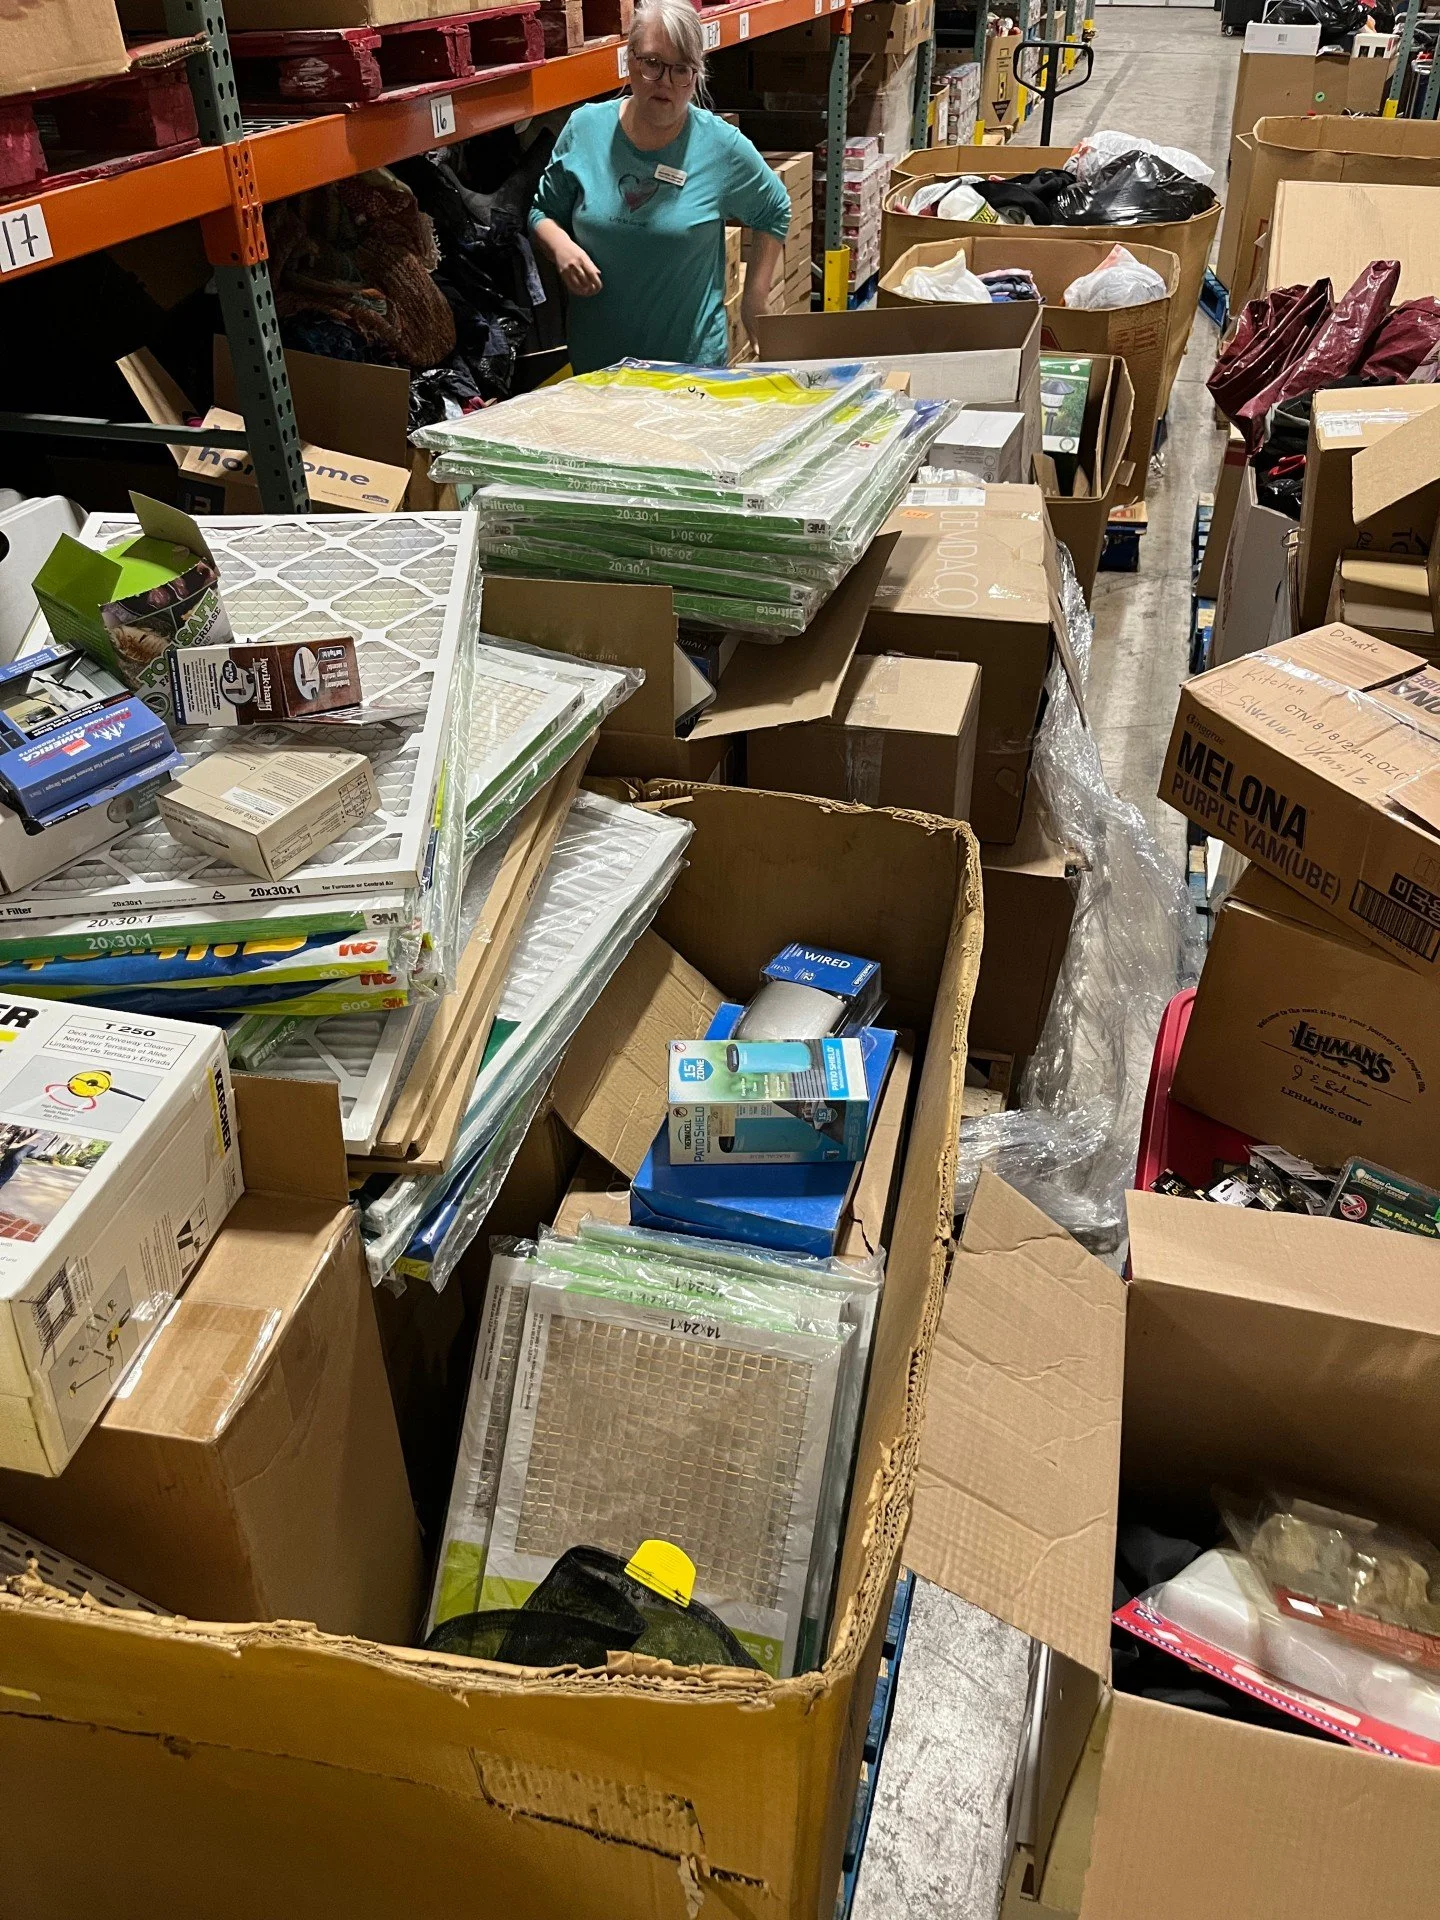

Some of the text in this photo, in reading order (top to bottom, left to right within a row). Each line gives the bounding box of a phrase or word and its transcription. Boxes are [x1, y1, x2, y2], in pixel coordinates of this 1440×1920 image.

[435, 104, 449, 132] 16
[2, 212, 39, 266] 17
[616, 509, 660, 522] 20x30x1
[671, 529, 714, 544] 20x30x1
[807, 522, 826, 534] 3M
[609, 561, 651, 577] 20x30x1
[933, 510, 979, 610] DEMDACO
[177, 588, 219, 648] SAFE
[194, 606, 222, 646] GREASE
[1329, 628, 1379, 655] Donate
[1242, 666, 1305, 695] Kitchen
[73, 709, 91, 721] Screen
[91, 704, 104, 713] Flat
[18, 707, 128, 757] FAMILY HOME SAFETY PRODUCTS
[32, 725, 53, 738] Straps
[52, 716, 72, 729] Safety
[21, 710, 132, 763] READY AMERICA
[103, 752, 125, 766] Universal
[60, 772, 77, 784] Safety
[77, 766, 93, 777] Screen
[45, 779, 61, 791] Straps
[1177, 730, 1307, 850] MELONA
[223, 804, 243, 816] alarm
[243, 812, 268, 826] smoke
[1171, 772, 1342, 905] PURPLE YAM(UBE)
[249, 885, 301, 898] 20x30x1
[6, 906, 32, 916] Filter
[112, 899, 143, 908] 20x30x1
[87, 914, 154, 929] 20x30x1
[371, 912, 399, 926] 3M
[86, 933, 154, 951] 20x30x1
[338, 940, 379, 957] 3M
[803, 950, 852, 970] WIRED
[341, 1001, 371, 1011] 600
[105, 1022, 157, 1038] T 250
[63, 1035, 102, 1049] Nettoyeur
[103, 1043, 137, 1053] Terrasse
[67, 1029, 176, 1053] Deck and Driveway Cleaner
[1257, 1012, 1280, 1029] Welcome
[1320, 1009, 1337, 1018] stop
[1349, 1018, 1366, 1030] your
[1366, 1025, 1396, 1046] journey
[1394, 1044, 1402, 1052] to
[1405, 1057, 1423, 1081] simpler
[49, 1041, 90, 1053] Limpiador
[90, 1047, 101, 1055] de
[102, 1050, 132, 1060] Terraza
[139, 1056, 171, 1067] Entrada
[1289, 1019, 1396, 1084] LEHMAN'S
[696, 1059, 706, 1081] ZONE
[827, 1047, 840, 1091] PATIO SHIELD
[1300, 1056, 1315, 1066] FOR
[1322, 1065, 1351, 1081] SIMPLER
[1352, 1079, 1369, 1088] LIFE
[1280, 1086, 1363, 1127] LEHMANS.COM
[693, 1105, 705, 1163] PATIO SHIELD
[1162, 1178, 1176, 1191] Brass
[1360, 1178, 1407, 1201] ENERGY SAVER
[1363, 1173, 1410, 1198] Wireless Command
[1375, 1204, 1394, 1217] Lamp
[1393, 1212, 1418, 1229] Plug-in
[1418, 1223, 1436, 1235] Alert
[669, 1317, 721, 1339] 14x24x1
